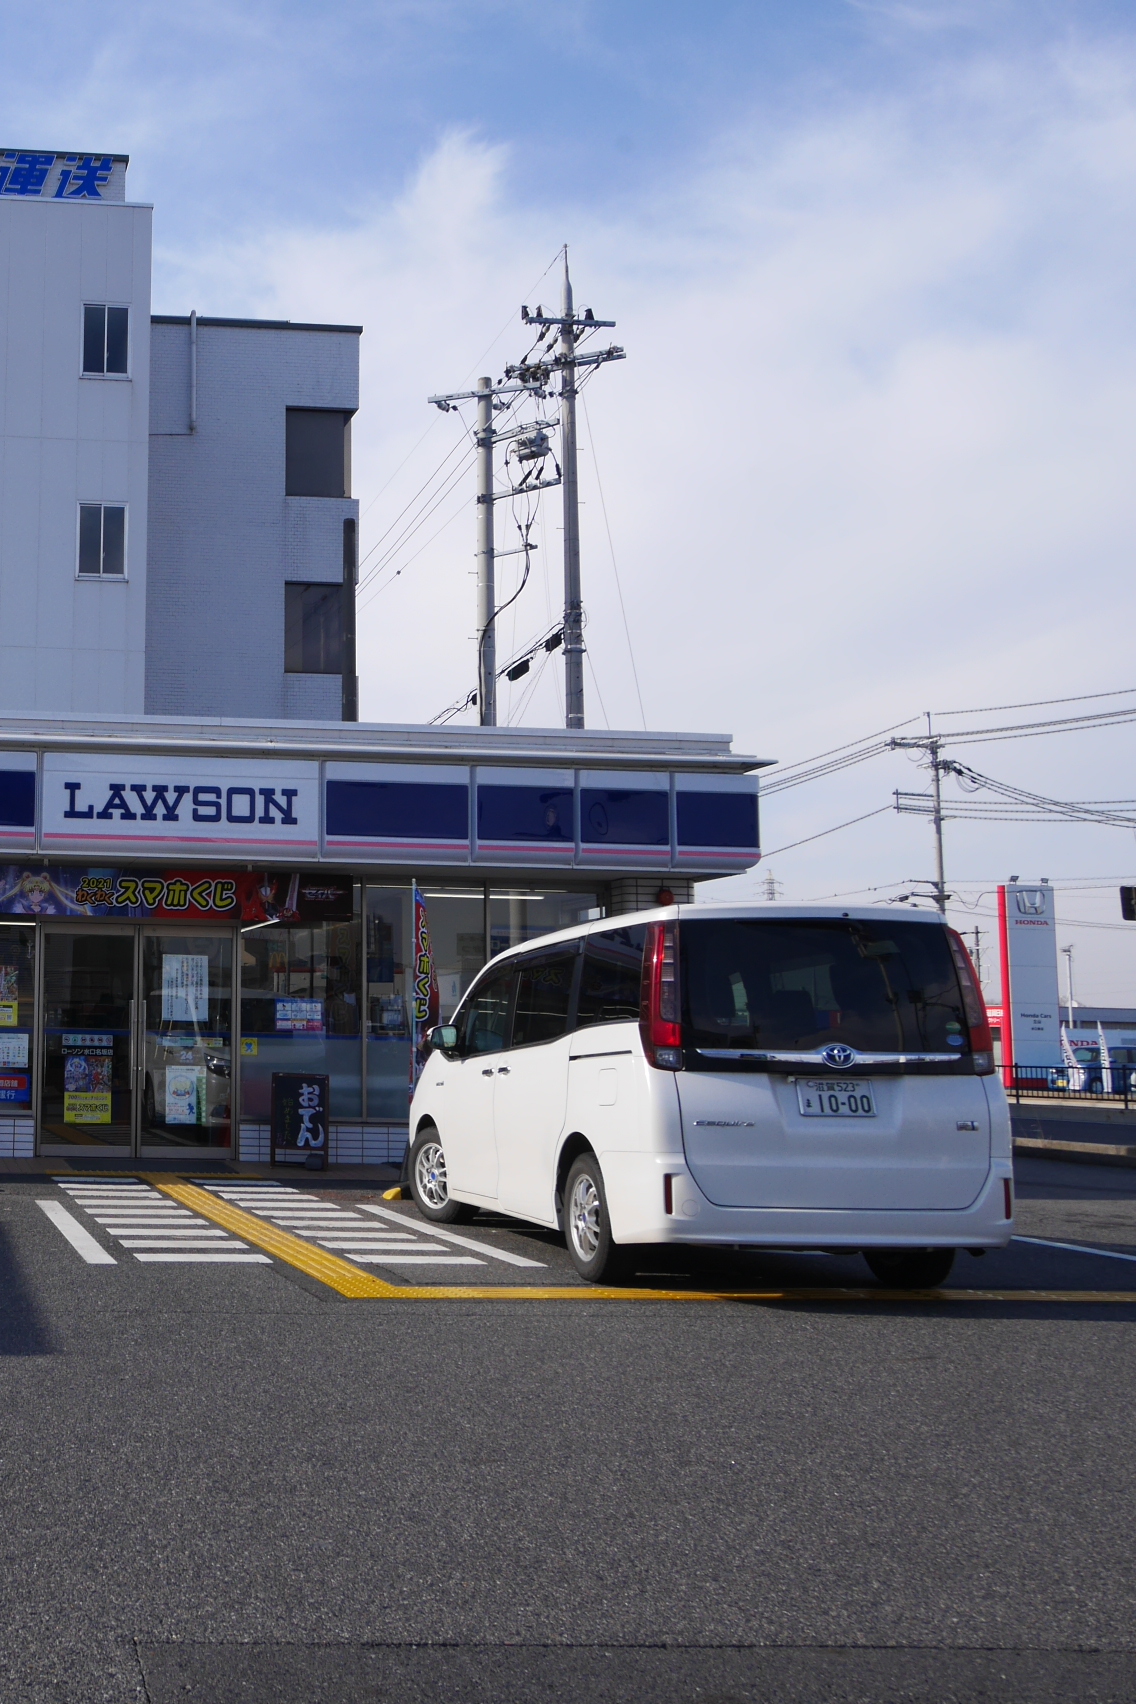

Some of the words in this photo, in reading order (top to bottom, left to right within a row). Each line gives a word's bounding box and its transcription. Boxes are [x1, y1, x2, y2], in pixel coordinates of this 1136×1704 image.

[63, 782, 298, 825] LAWSON
[75, 888, 115, 906] わくわく
[81, 877, 112, 890] 2021
[116, 878, 237, 911] スマホくじ
[296, 1082, 325, 1148] おでん
[818, 1093, 872, 1114] 10-00
